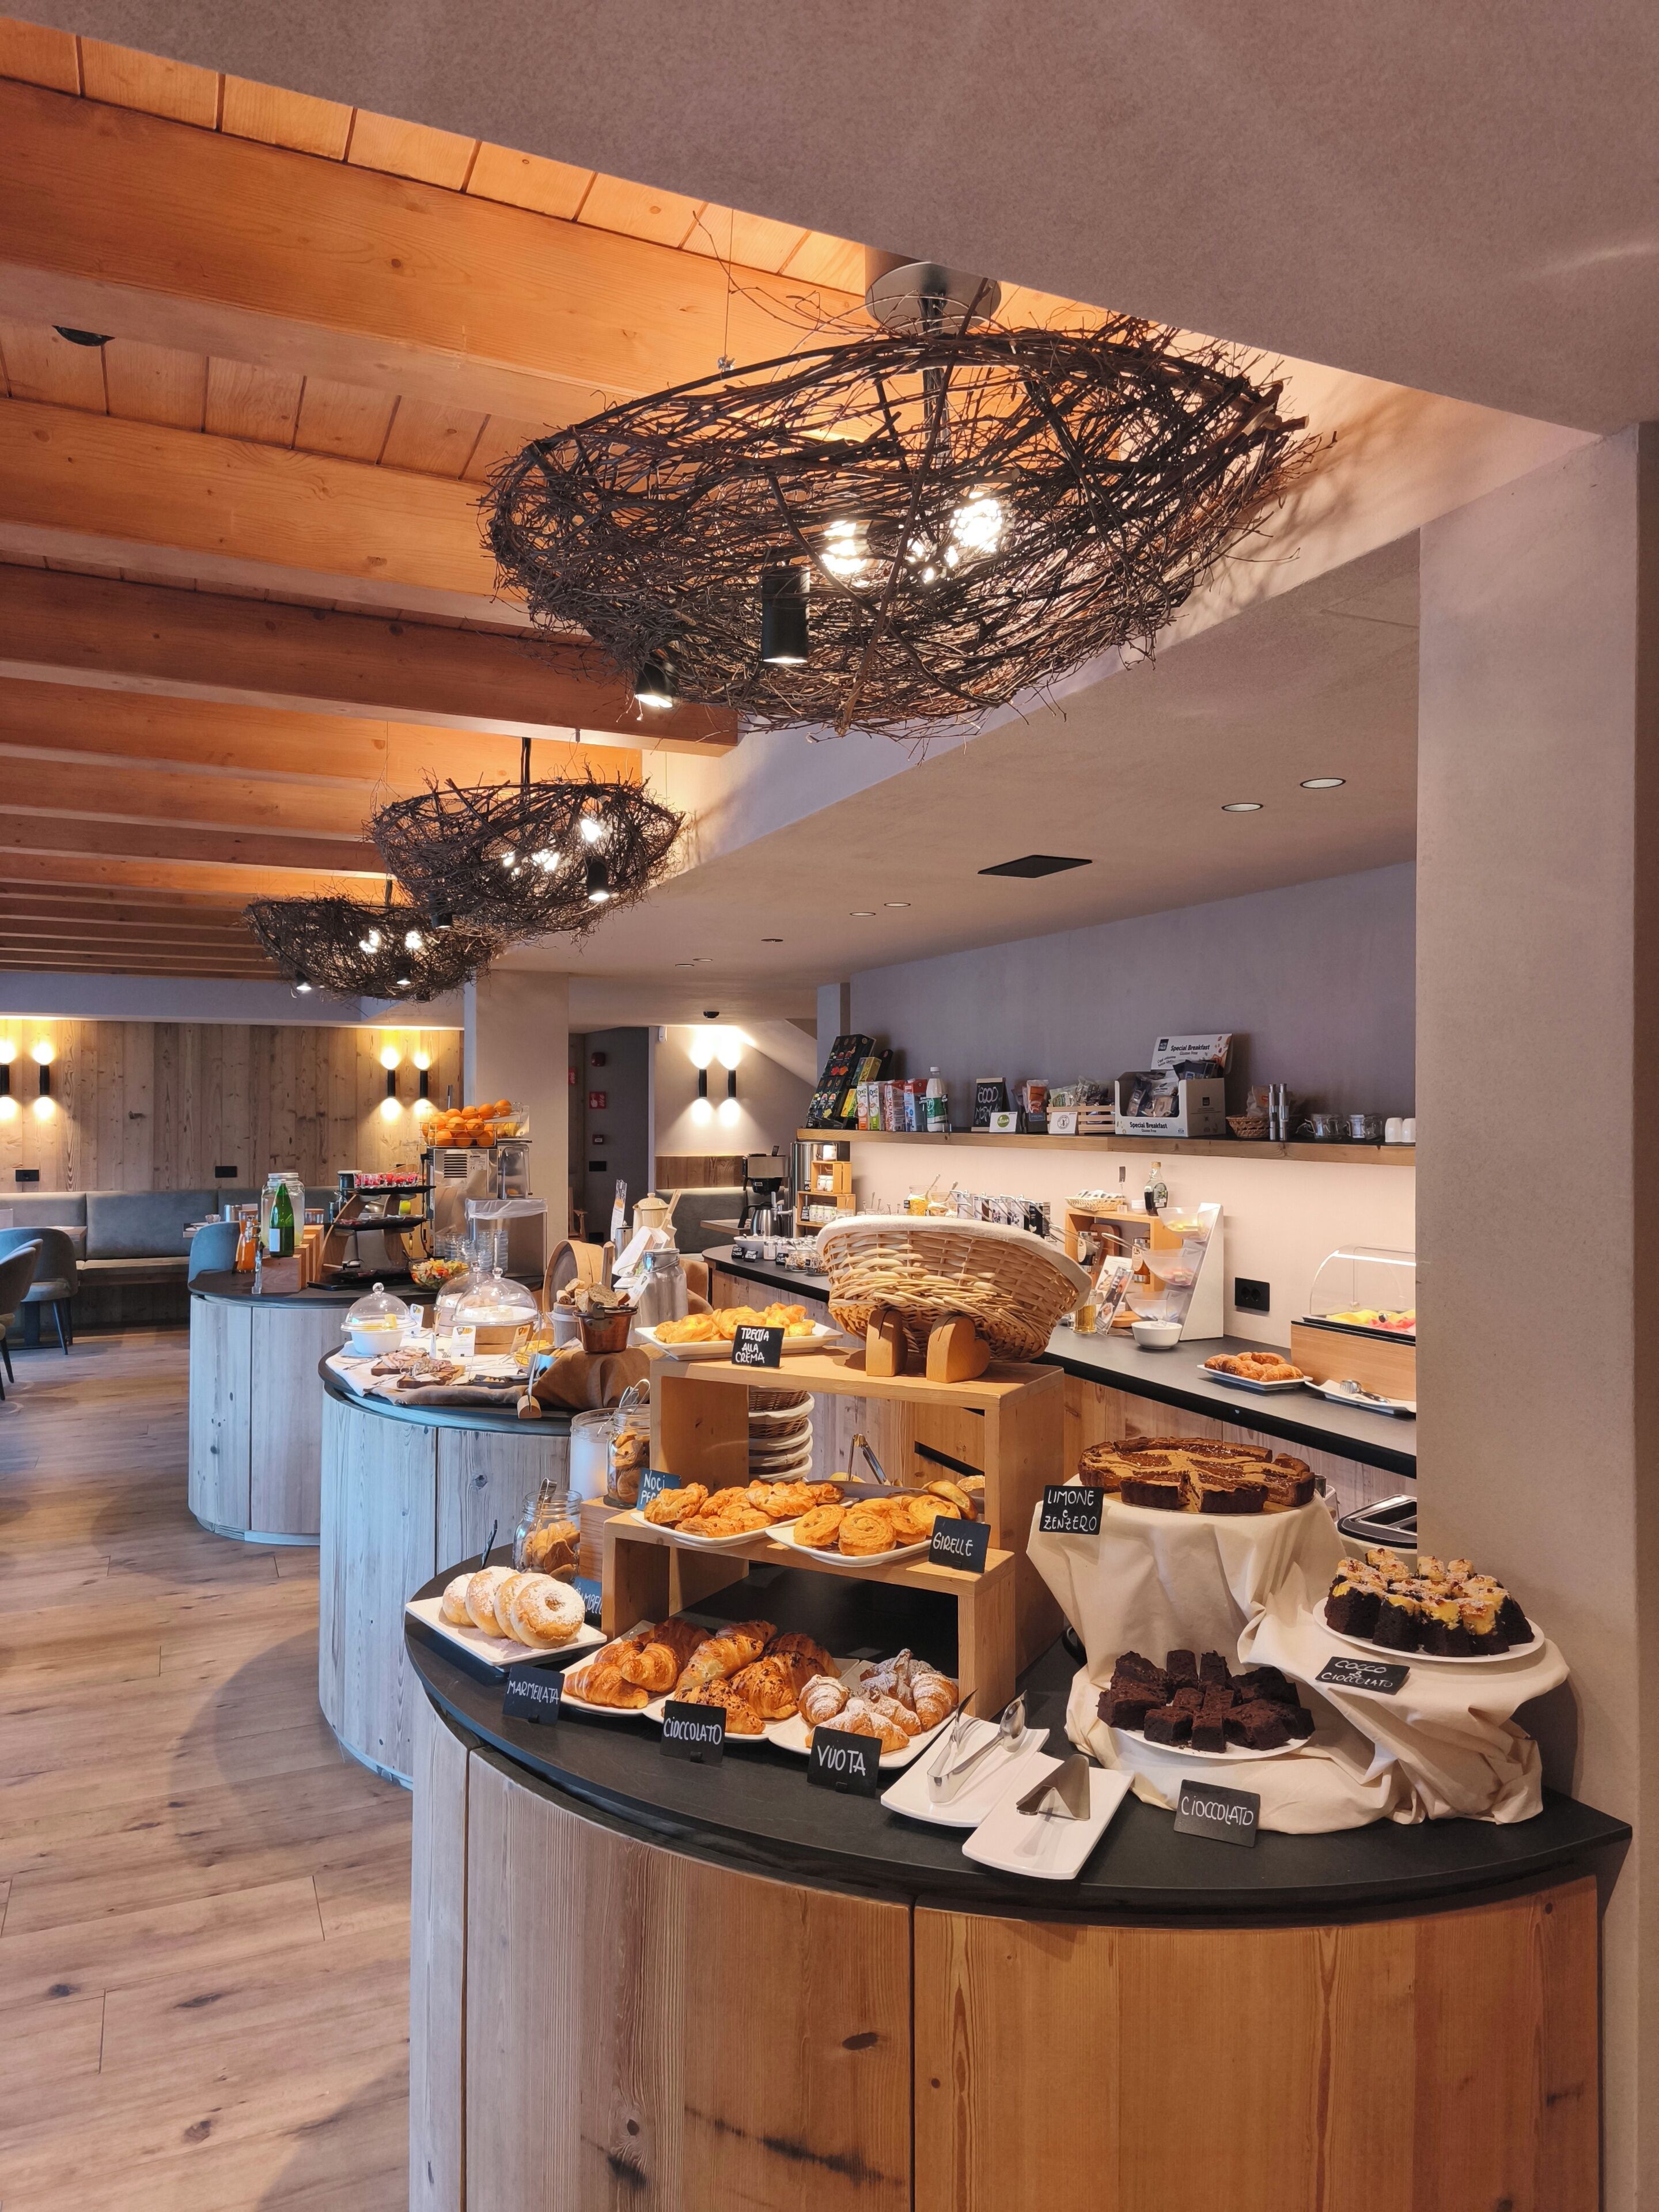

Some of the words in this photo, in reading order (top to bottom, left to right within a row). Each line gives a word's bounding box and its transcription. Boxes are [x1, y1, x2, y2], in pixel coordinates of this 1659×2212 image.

[978, 1086, 999, 1104] GOOD
[741, 1342, 759, 1354] ALLA
[735, 1351, 765, 1363] CREMA
[1047, 1489, 1094, 1506] LIMONE
[1062, 1509, 1069, 1518] e
[1043, 1515, 1097, 1532] ZENZERO
[933, 1532, 974, 1556] GIRELLE
[1335, 1660, 1387, 1673] COCCO
[1321, 1672, 1393, 1688] CIOCCOLATO
[507, 1680, 559, 1705] MARMELLATA
[817, 1745, 866, 1777] VUOTA
